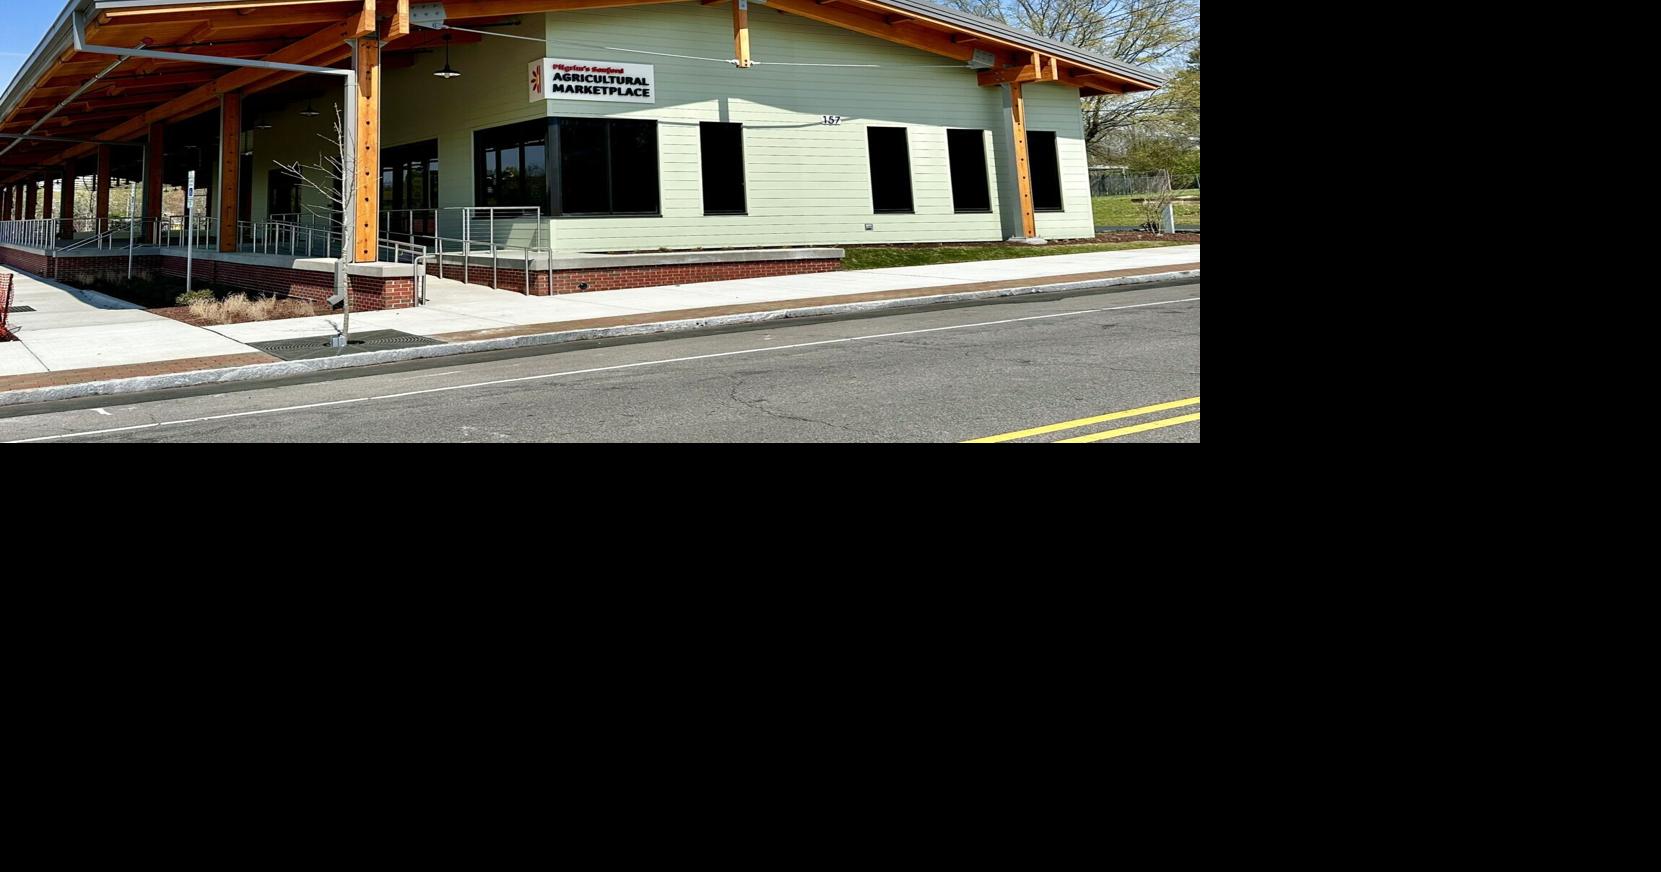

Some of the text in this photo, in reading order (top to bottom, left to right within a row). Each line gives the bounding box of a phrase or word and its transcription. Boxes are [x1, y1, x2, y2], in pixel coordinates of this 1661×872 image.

[553, 64, 590, 73] Pilgrim's
[553, 73, 650, 86] AGRICULTURAL
[553, 84, 650, 97] MARKETPLACE
[823, 115, 841, 124] 157
